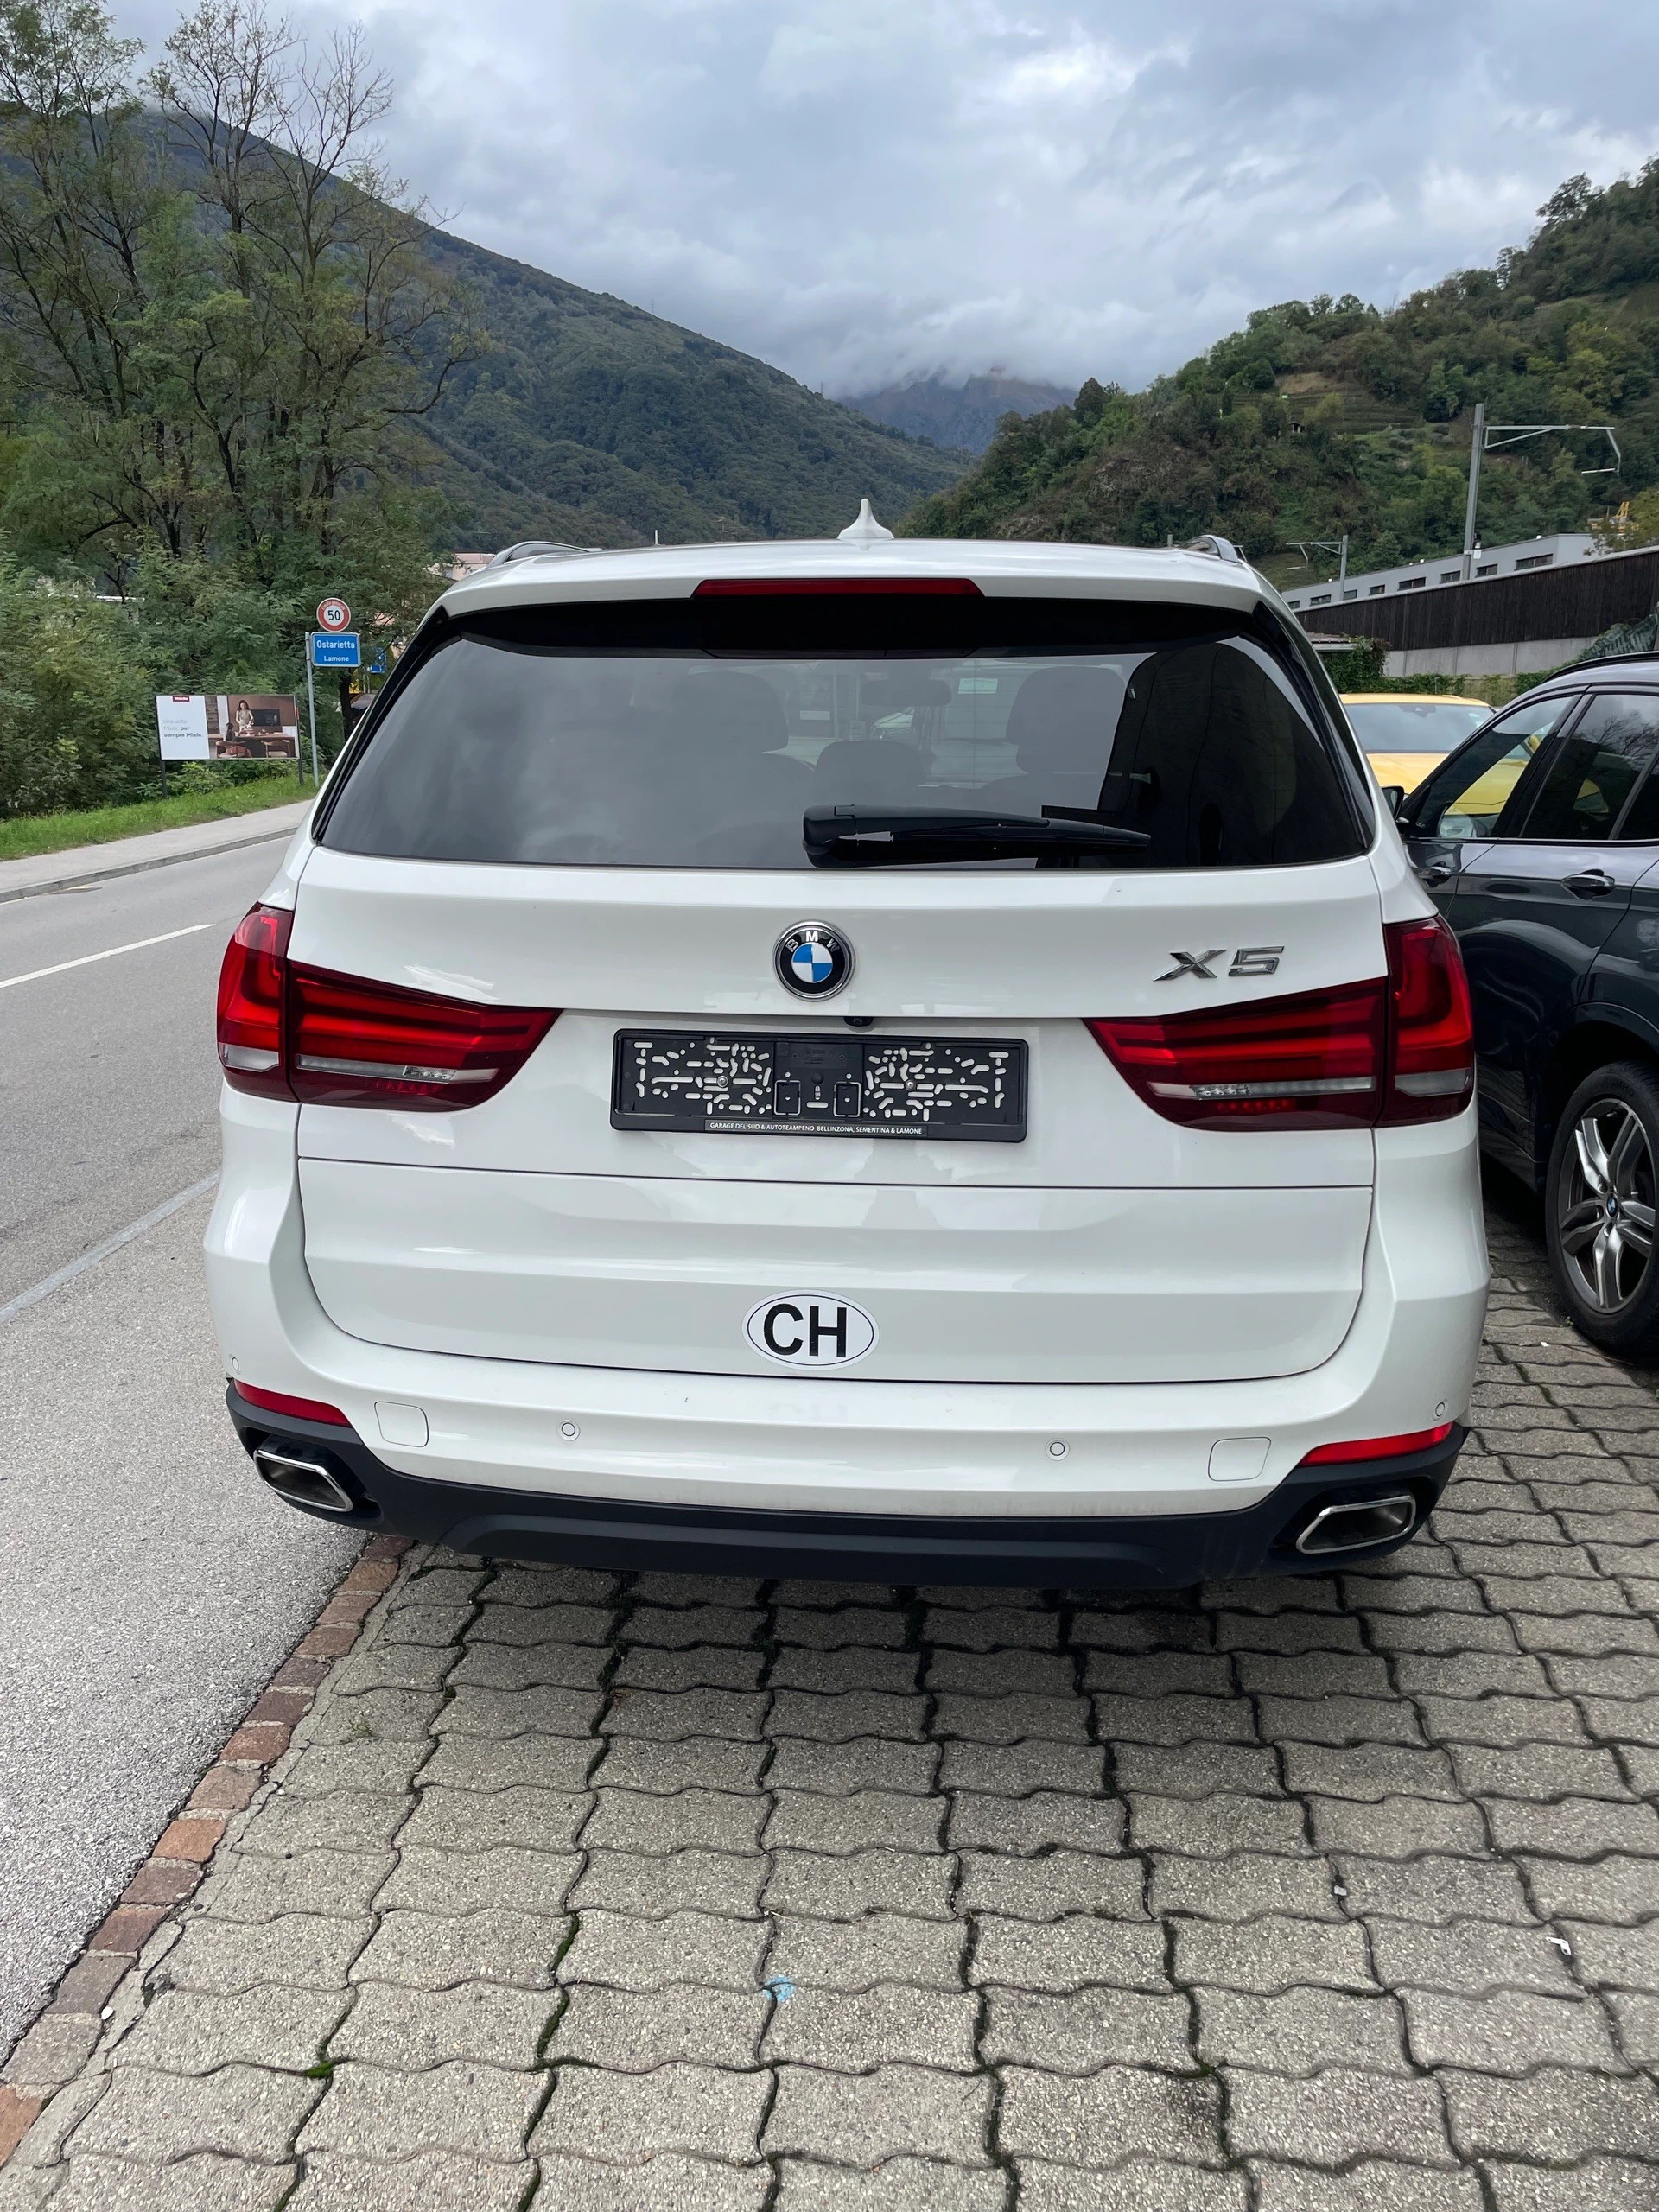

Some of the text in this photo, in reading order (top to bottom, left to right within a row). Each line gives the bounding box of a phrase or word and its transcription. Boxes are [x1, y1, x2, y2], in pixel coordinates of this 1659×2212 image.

[327, 609, 340, 620] 50
[316, 639, 355, 649] Ostarietta
[785, 931, 840, 952] BMW
[1154, 946, 1285, 982] X5
[763, 1303, 847, 1358] CH
